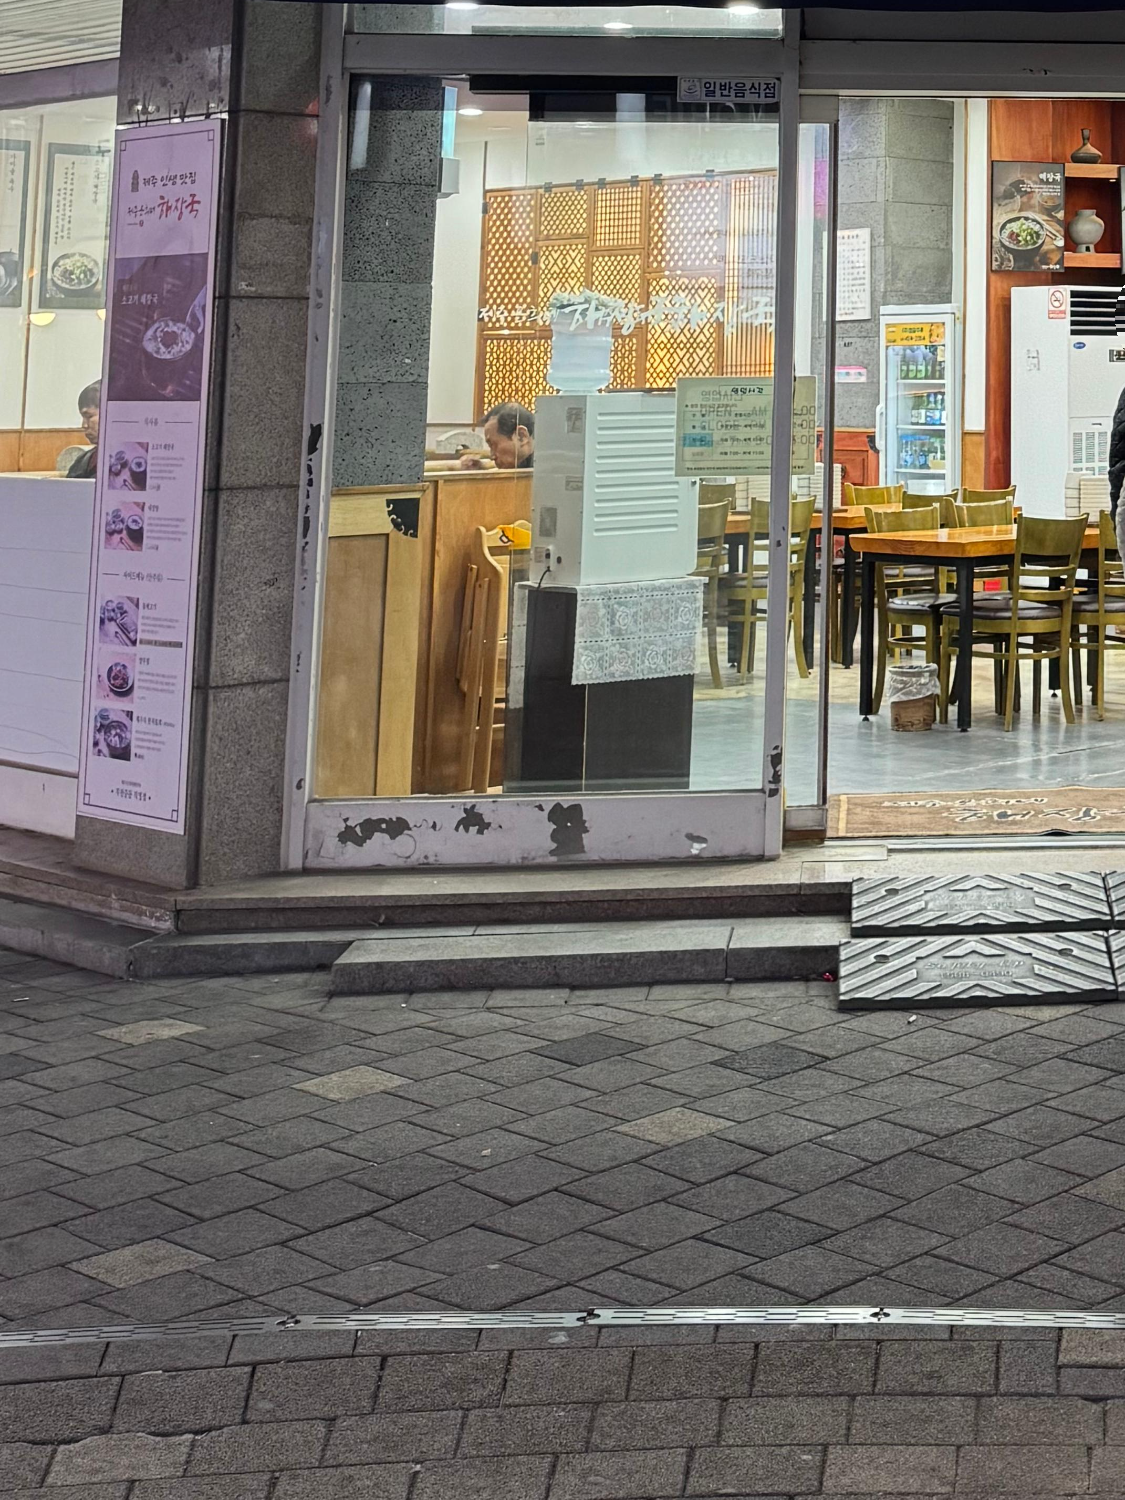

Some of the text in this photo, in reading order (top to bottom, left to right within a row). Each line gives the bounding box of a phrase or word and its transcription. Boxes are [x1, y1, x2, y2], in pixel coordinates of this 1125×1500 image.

[703, 80, 777, 99] 일반음식점
[142, 171, 197, 188] 제주 인생 맛집
[157, 193, 202, 222] 해장국
